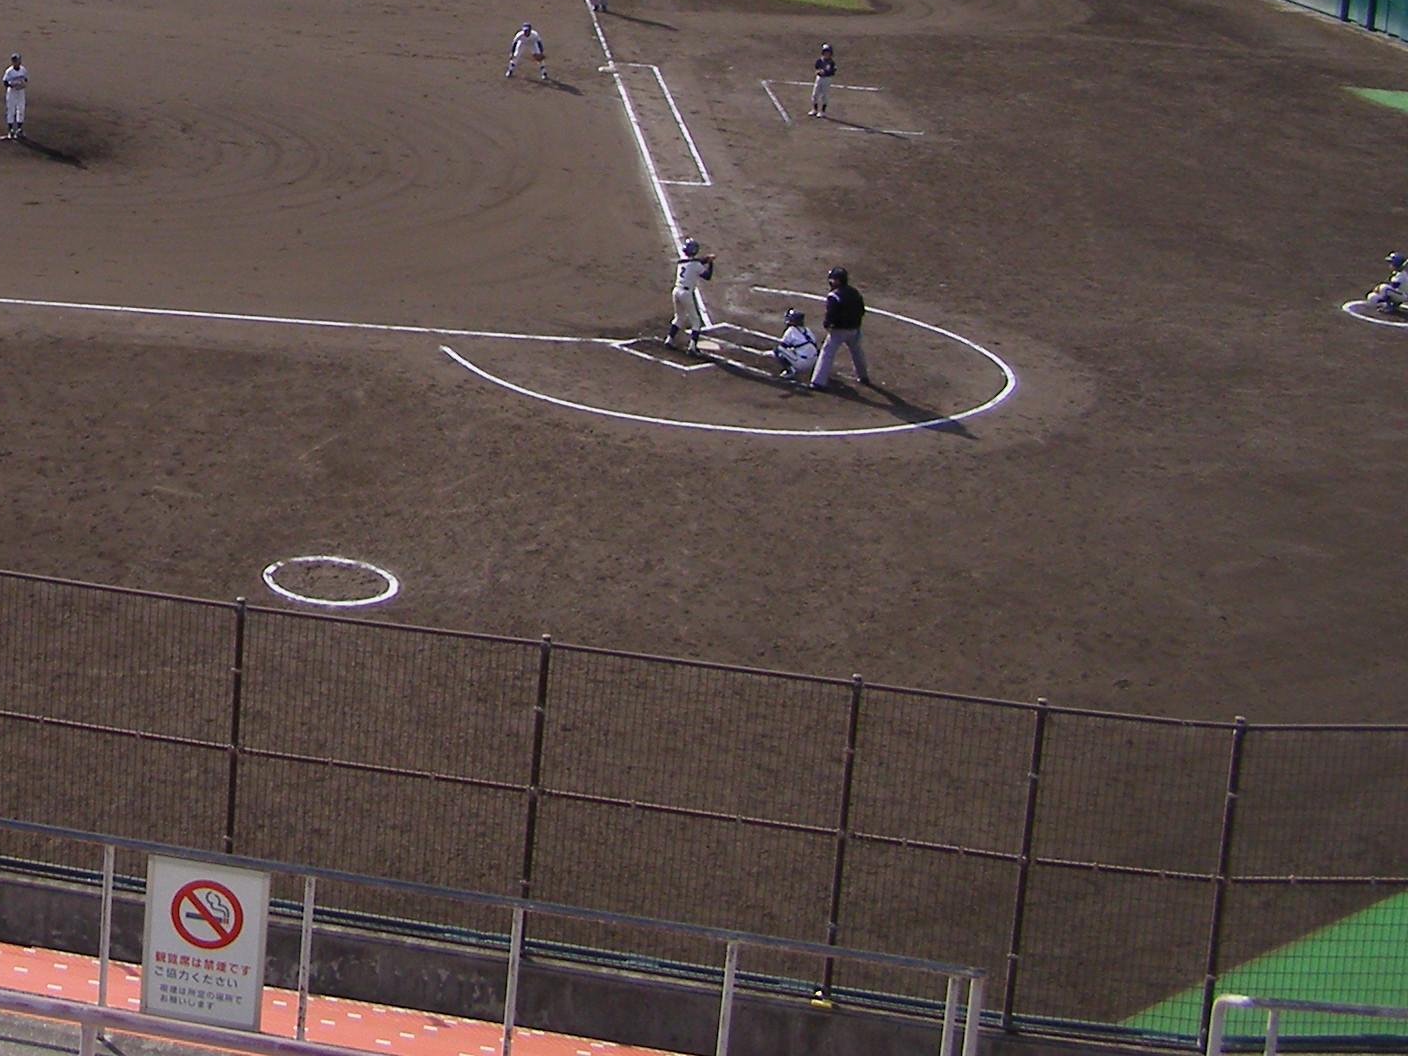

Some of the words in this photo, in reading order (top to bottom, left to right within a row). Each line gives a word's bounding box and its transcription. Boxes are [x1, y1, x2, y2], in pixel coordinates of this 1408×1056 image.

[679, 266, 687, 279] 2
[155, 951, 251, 976] 観覧席は禁煙です
[154, 965, 238, 988] ご協力ください
[160, 994, 215, 1010] お願いします
